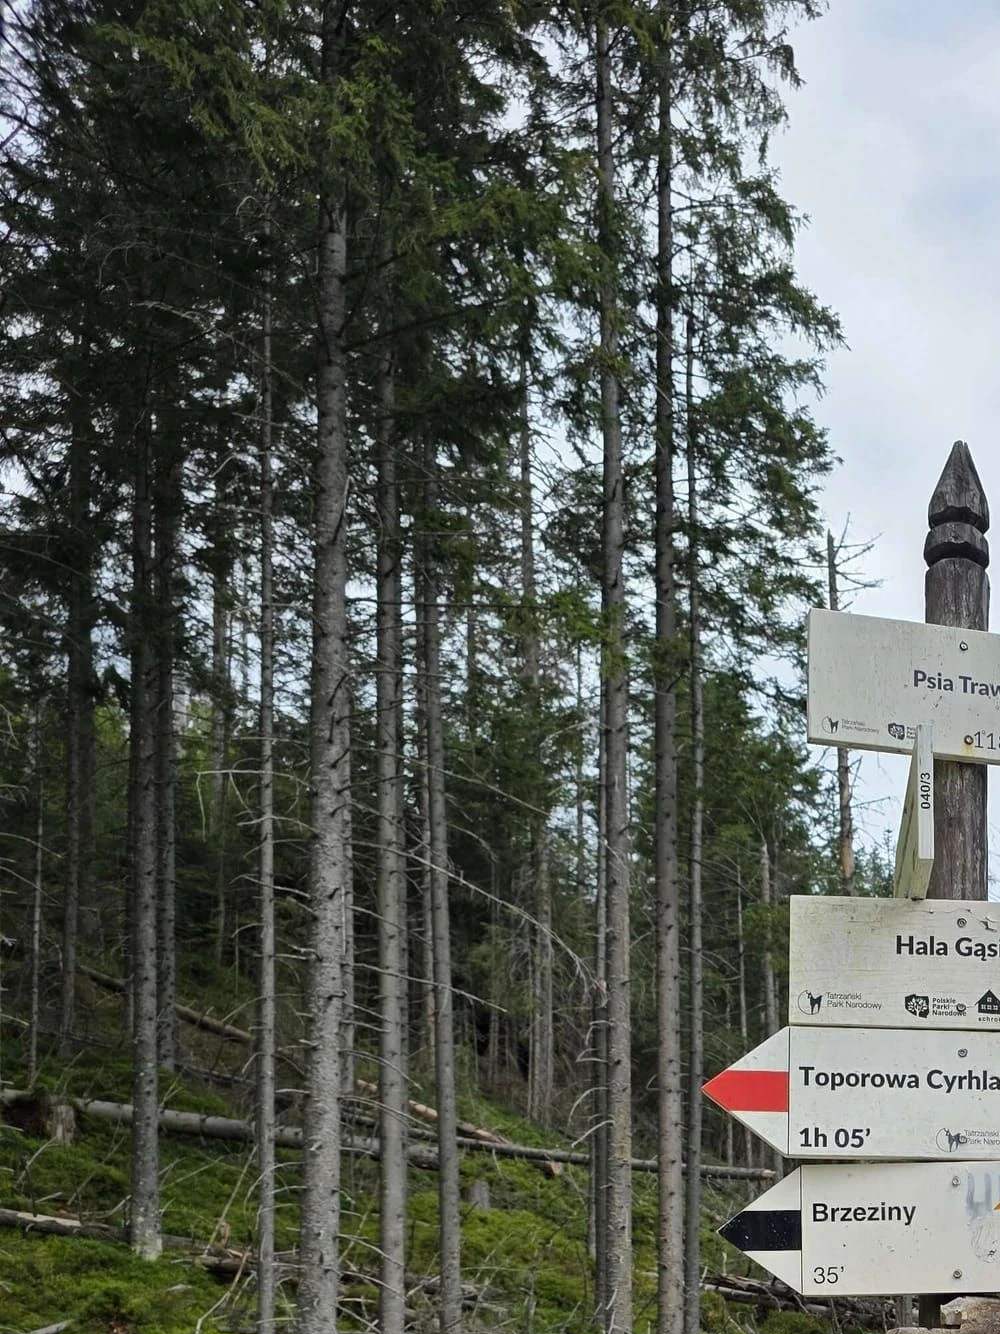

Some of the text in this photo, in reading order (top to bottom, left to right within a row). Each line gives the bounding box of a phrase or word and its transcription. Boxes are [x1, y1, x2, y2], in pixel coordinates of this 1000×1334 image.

[913, 670, 953, 691] Psia
[920, 772, 931, 809] 040/3
[896, 935, 948, 956] Hala
[826, 1000, 882, 1010] Park Narodowy
[932, 1009, 967, 1017] Narodowe
[799, 1066, 1000, 1093] Toporowa Cyrhla
[799, 1127, 828, 1148] 1h
[812, 1202, 917, 1226] Brzeziny
